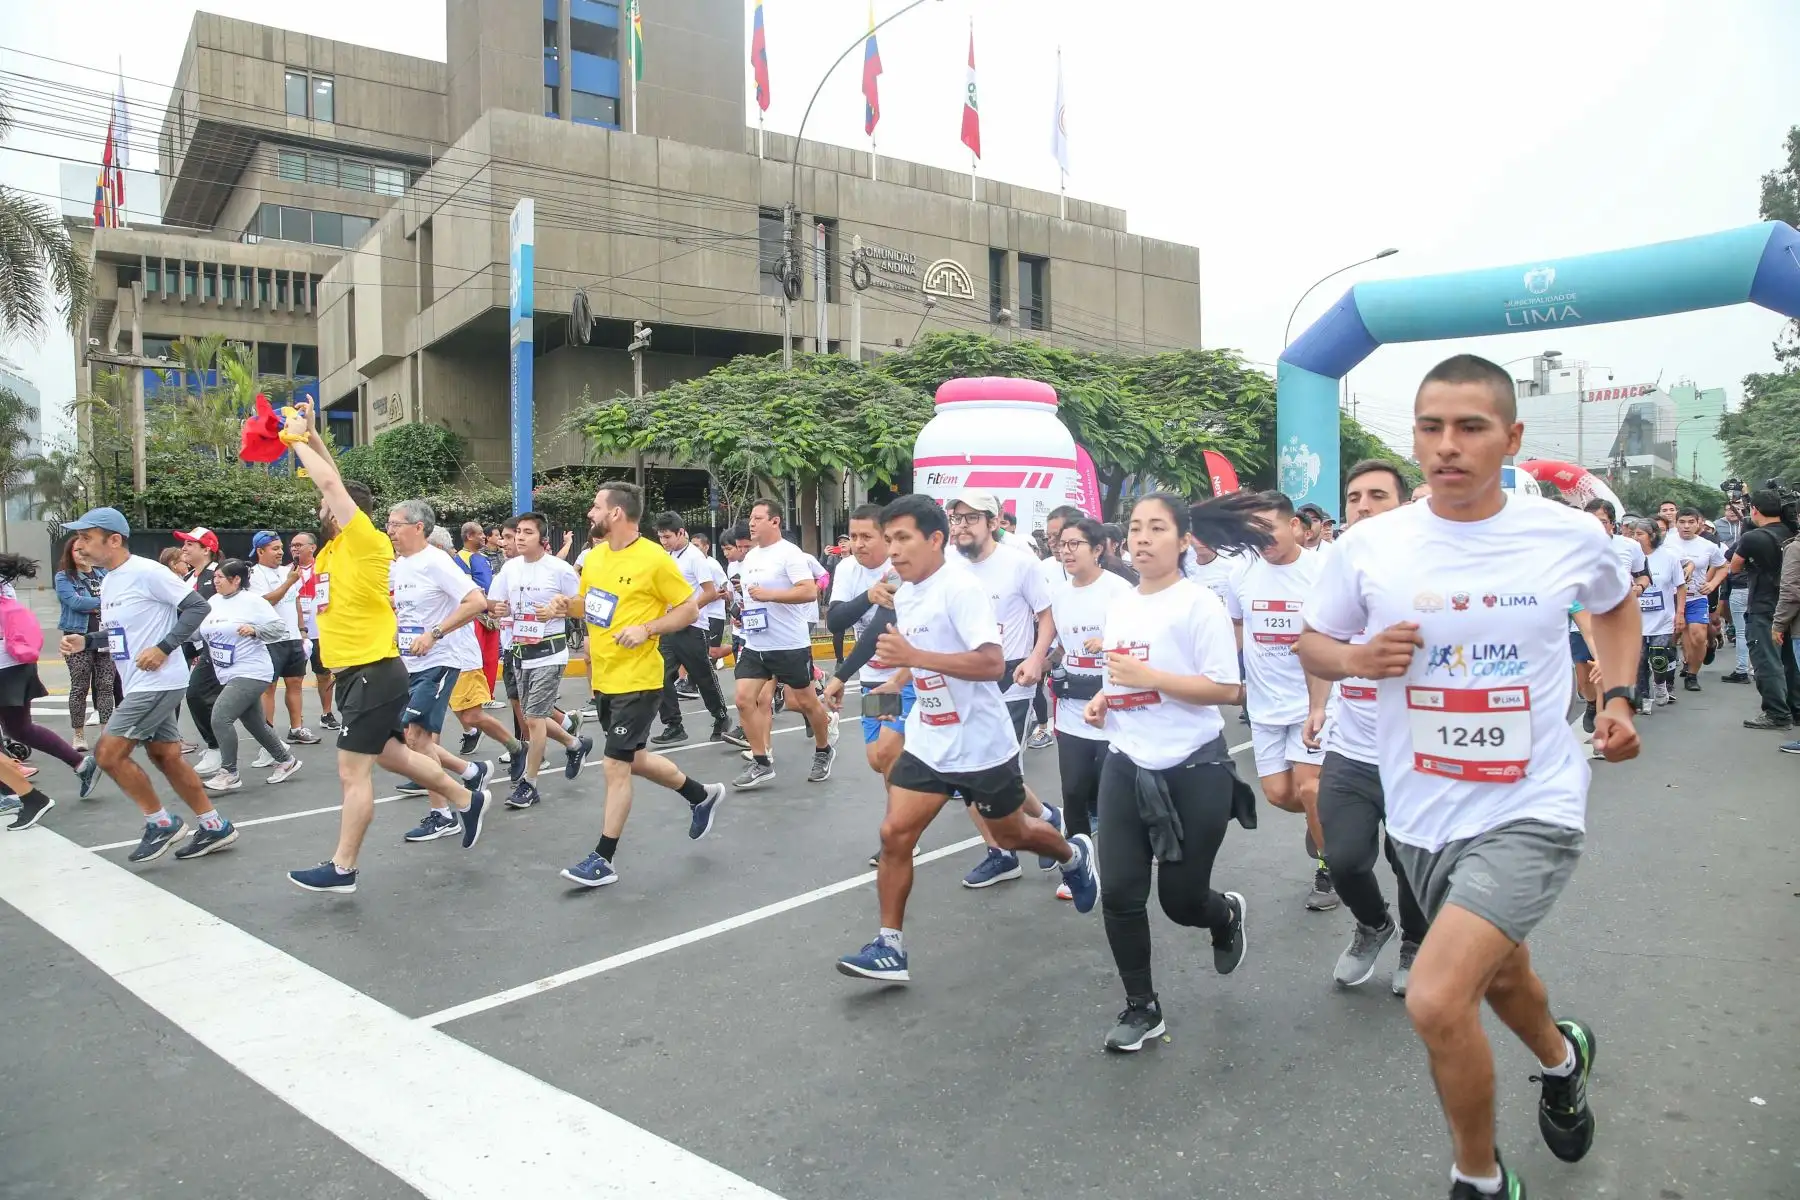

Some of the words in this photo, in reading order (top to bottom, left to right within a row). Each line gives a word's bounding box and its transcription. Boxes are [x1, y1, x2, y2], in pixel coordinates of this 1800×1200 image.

[860, 246, 917, 265] COMUNIDAD
[880, 260, 916, 276] ANDINA
[1566, 292, 1577, 301] DE
[1505, 305, 1582, 326] LIMA
[1500, 595, 1538, 607] LIMA
[519, 624, 539, 634] 2346
[1263, 617, 1292, 629] 1231
[1471, 643, 1519, 660] LIMA
[1471, 660, 1529, 677] CORRE
[1501, 695, 1521, 704] LIMA
[1436, 725, 1506, 748] 1249
